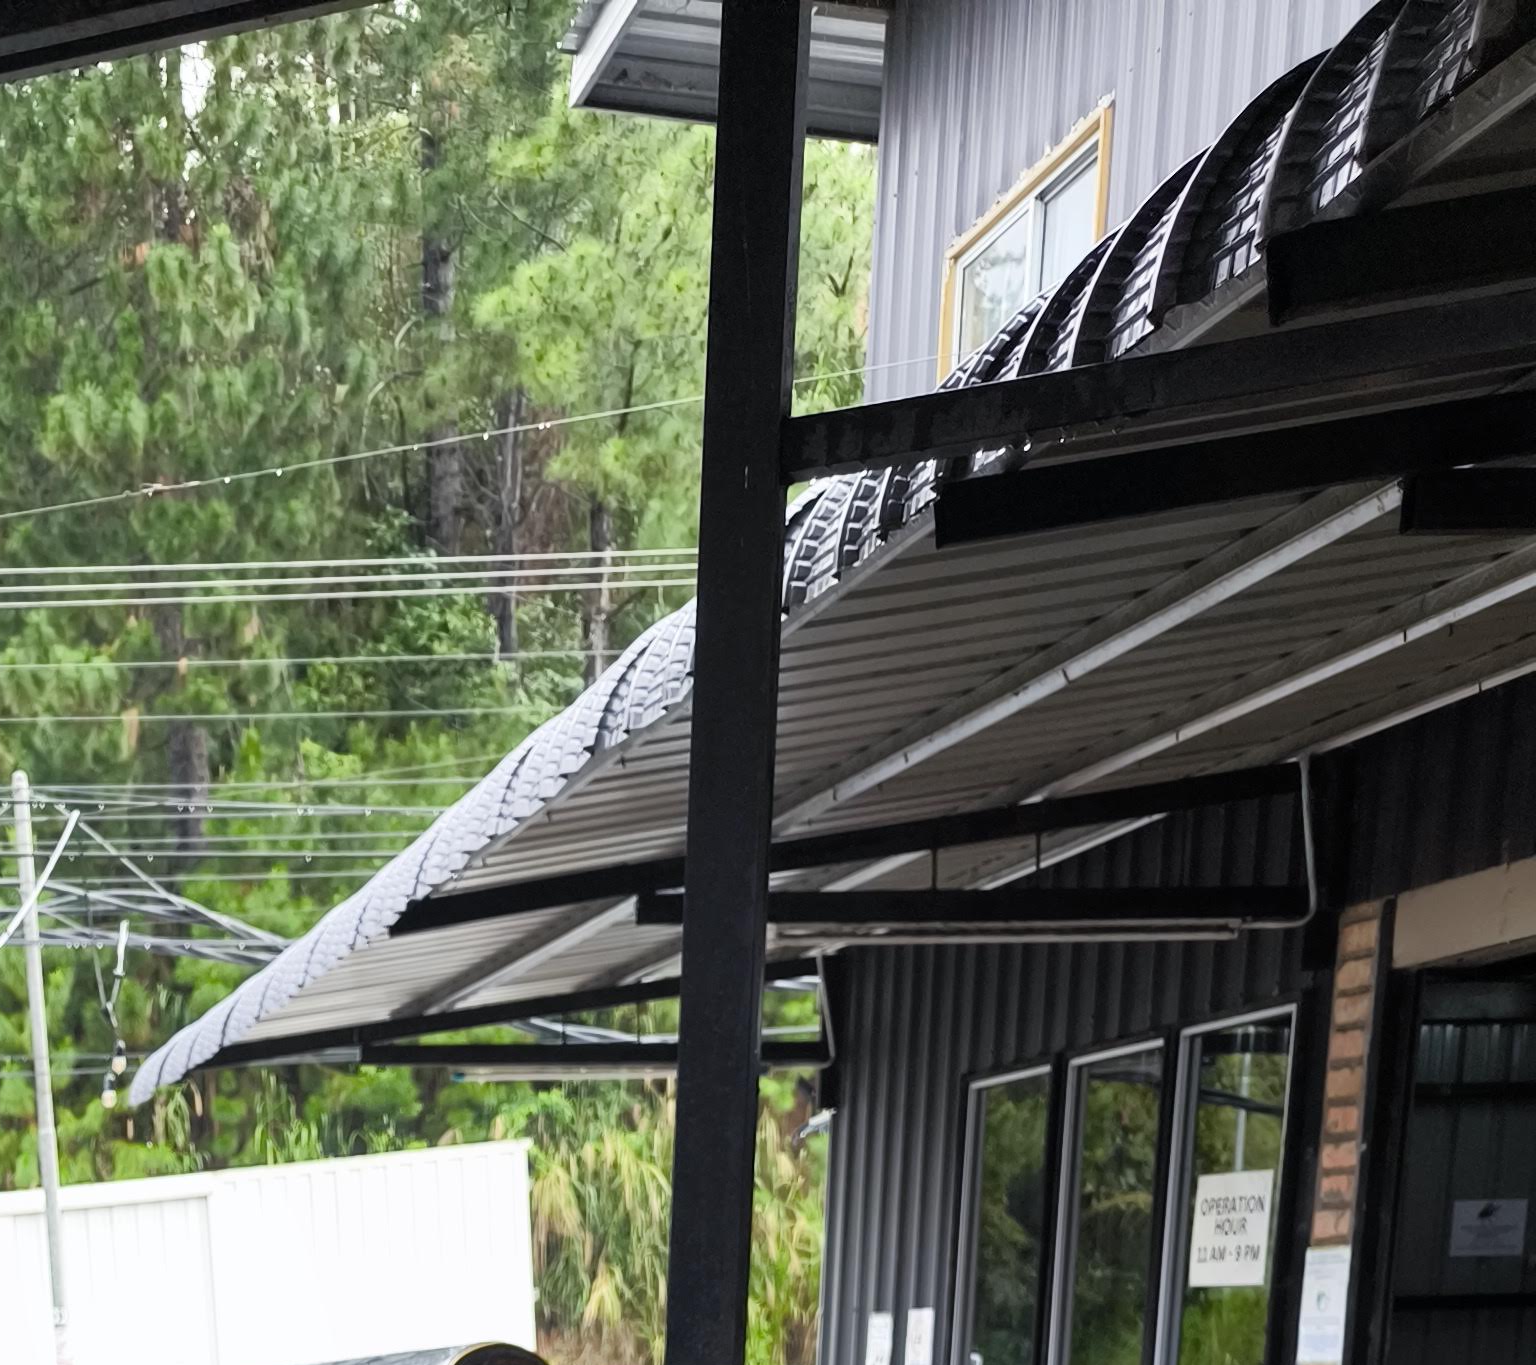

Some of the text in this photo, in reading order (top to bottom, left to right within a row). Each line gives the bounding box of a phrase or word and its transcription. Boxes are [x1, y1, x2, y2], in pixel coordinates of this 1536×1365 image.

[1200, 1195, 1265, 1216] OPERATION
[1214, 1217, 1248, 1236] HOUR
[1209, 1245, 1226, 1262] AM
[1244, 1244, 1261, 1261] PM
